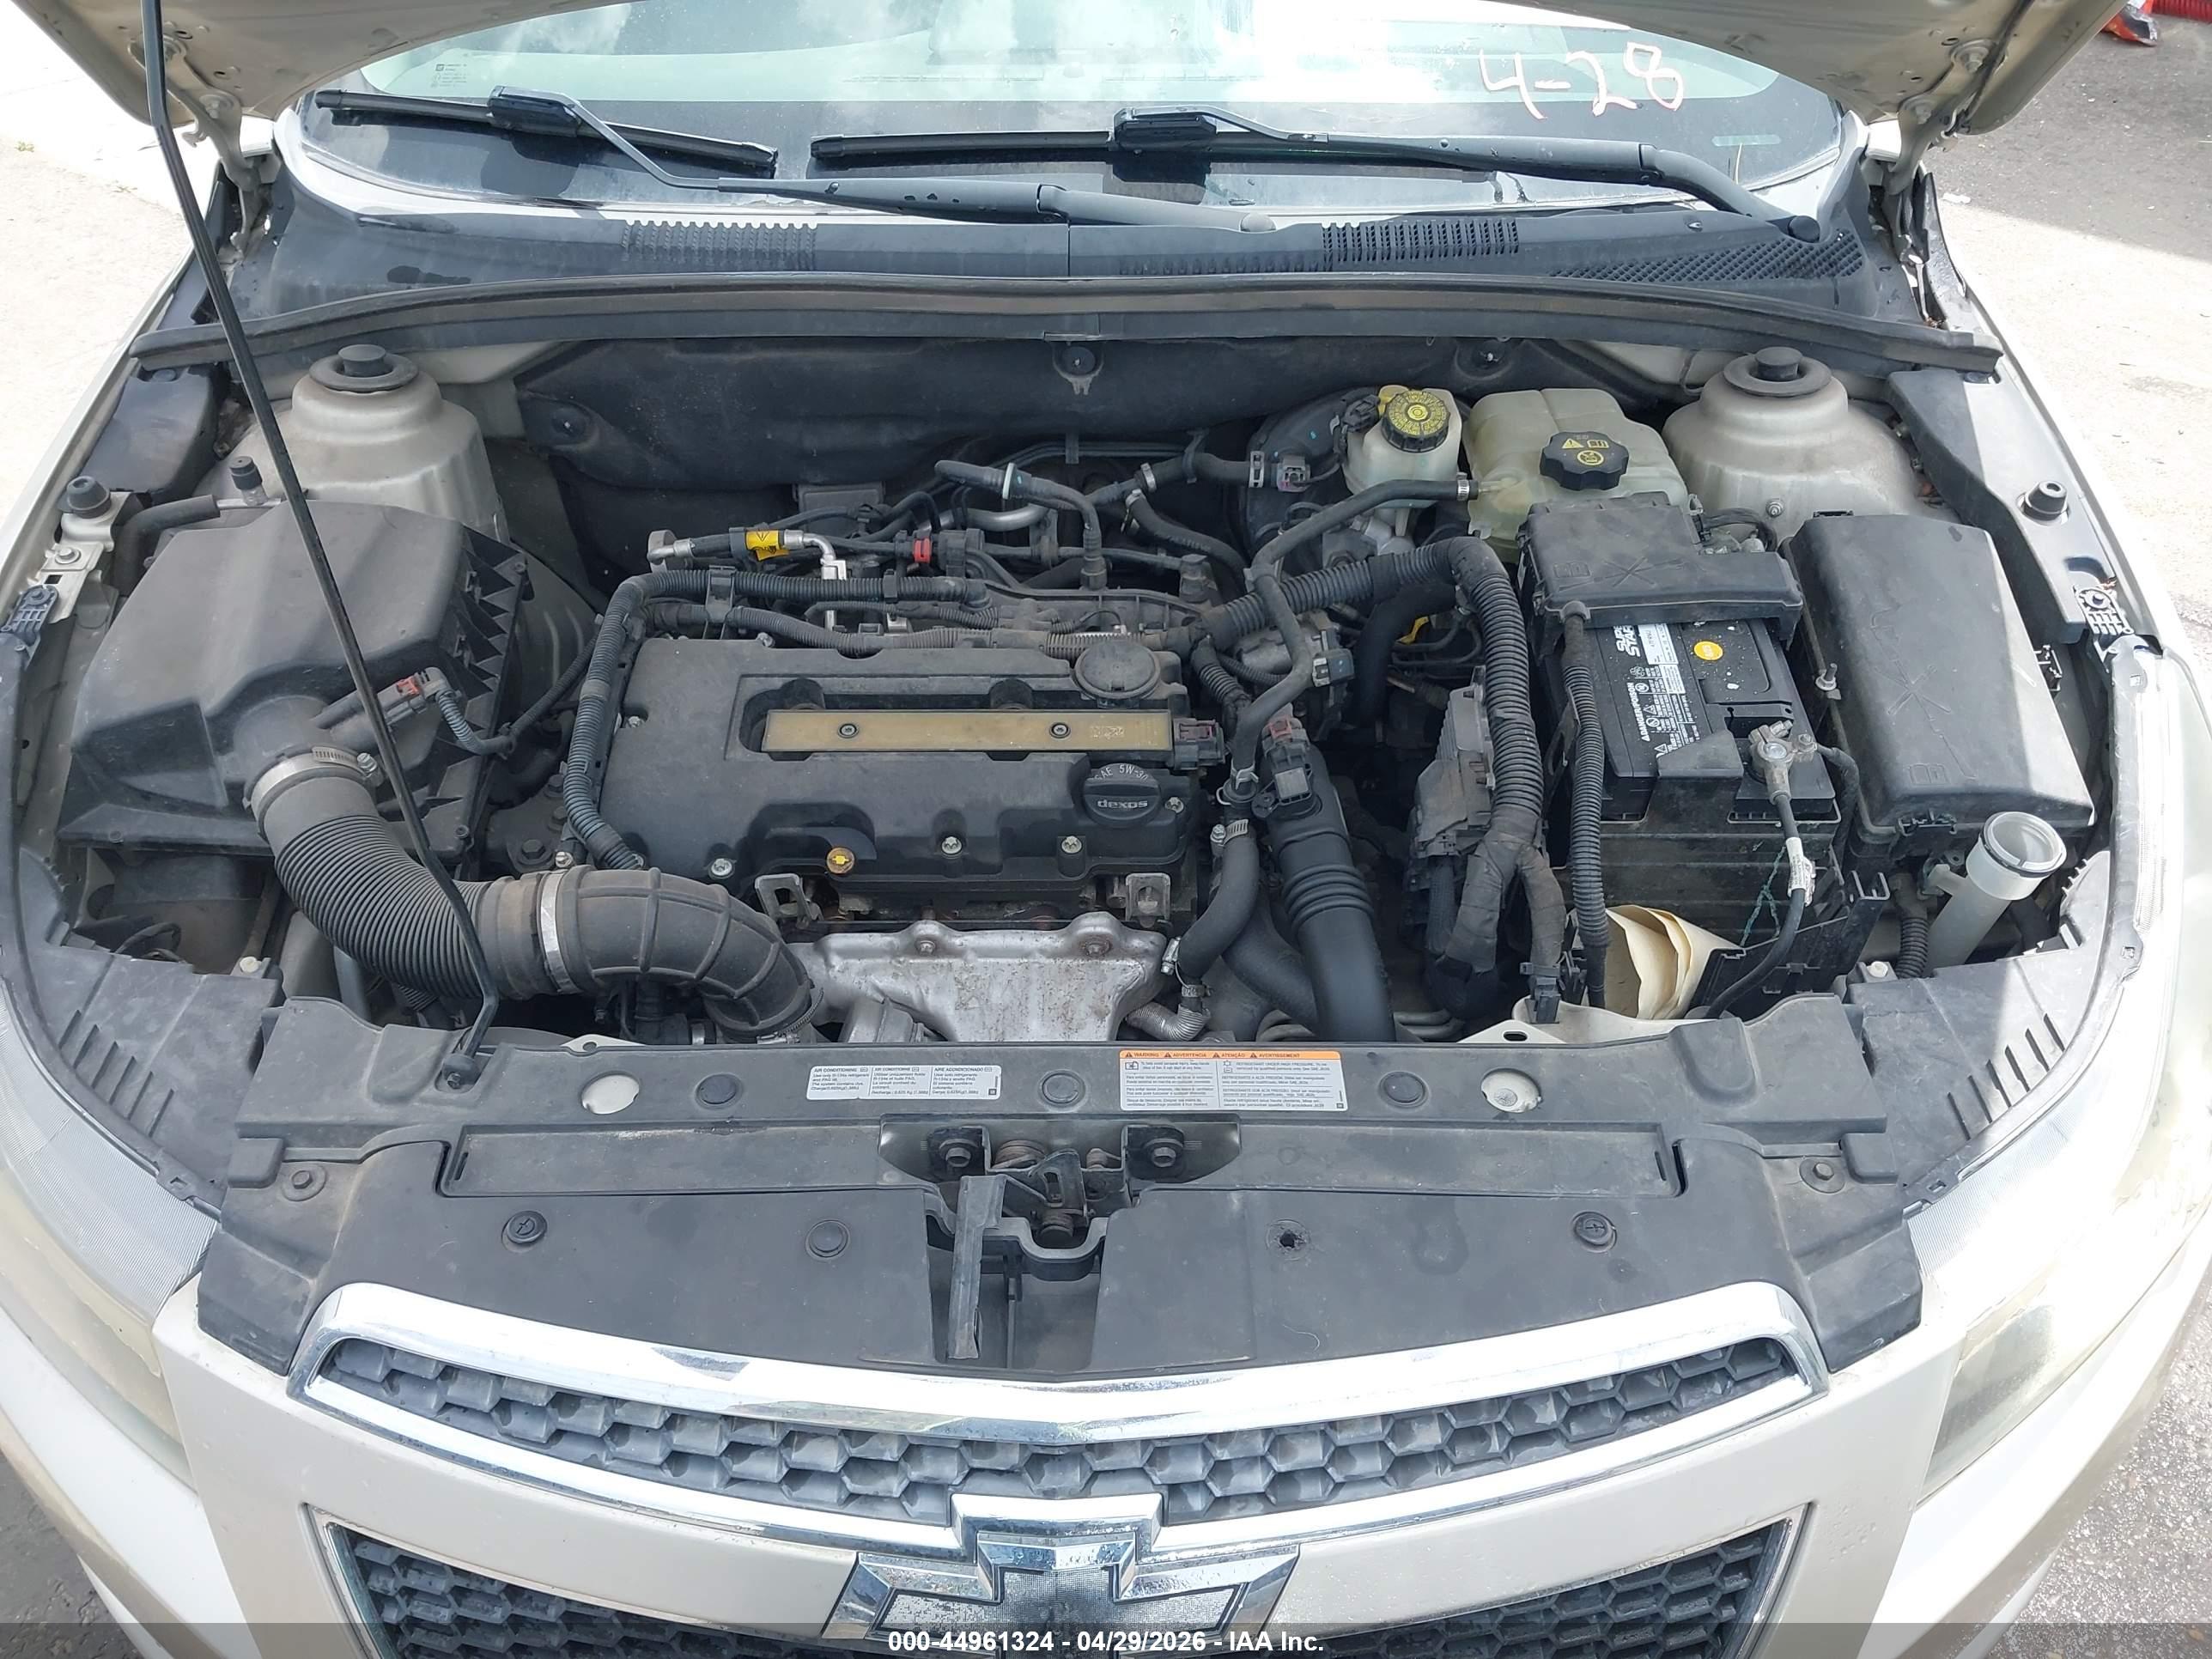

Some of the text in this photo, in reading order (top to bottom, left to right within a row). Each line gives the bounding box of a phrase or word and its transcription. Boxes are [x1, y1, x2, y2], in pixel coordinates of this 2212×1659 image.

[1479, 41, 1684, 118] 4-28
[1613, 626, 1626, 652] SUPE
[1094, 764, 1149, 781] SAE 5W-30
[1097, 799, 1148, 809] dexos
